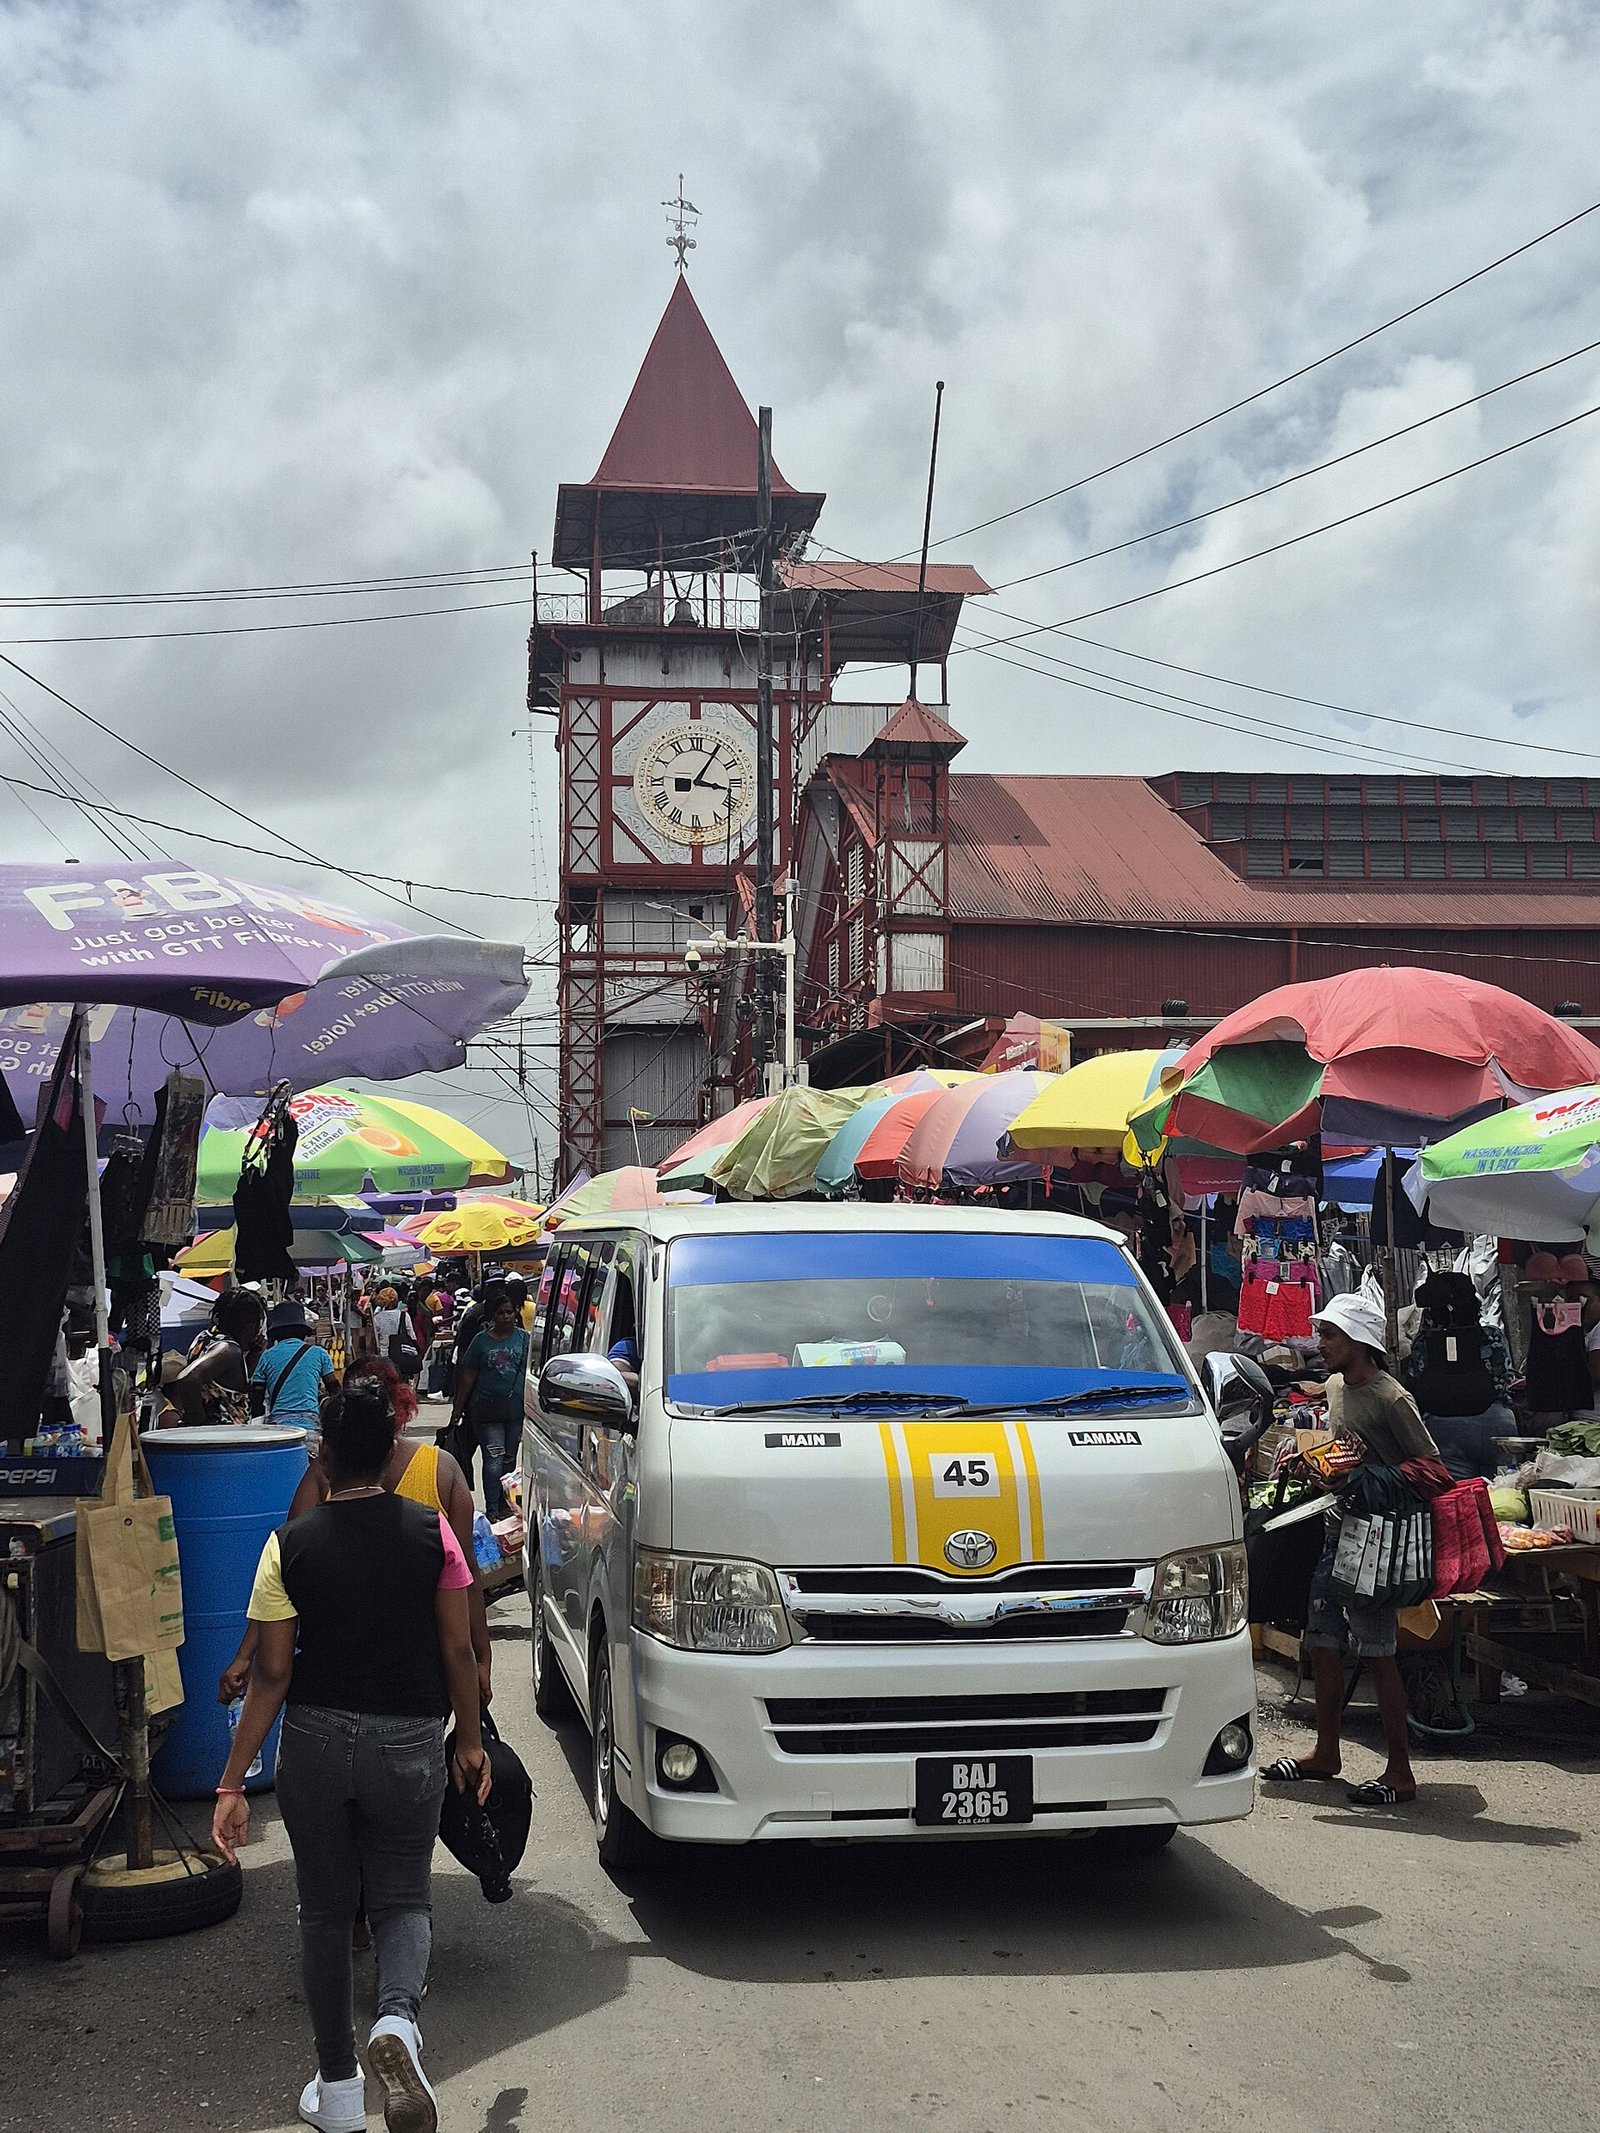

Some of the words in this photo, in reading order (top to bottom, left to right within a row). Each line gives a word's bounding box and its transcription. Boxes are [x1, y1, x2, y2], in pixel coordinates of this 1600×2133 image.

[688, 737, 703, 751] XII
[71, 930, 139, 951] Just
[144, 919, 200, 943] got
[204, 912, 295, 931] better
[80, 946, 155, 968] with
[162, 935, 225, 957] GTT
[233, 928, 324, 948] Fibre+
[193, 987, 252, 1013] Fibre
[301, 1130, 329, 1150] Extra
[302, 1127, 346, 1160] Perfumed
[1462, 1147, 1504, 1160] WASHING
[1504, 1143, 1545, 1157] MACHINE
[1477, 1160, 1487, 1173] IN
[1495, 1158, 1520, 1171] PACK
[781, 1433, 826, 1447] MAIN
[1072, 1431, 1138, 1446] LAMAHA
[0, 1468, 58, 1485] PEPSI
[943, 1459, 990, 1488] 45
[952, 1762, 997, 1790] BAJ
[941, 1791, 1009, 1819] 2365
